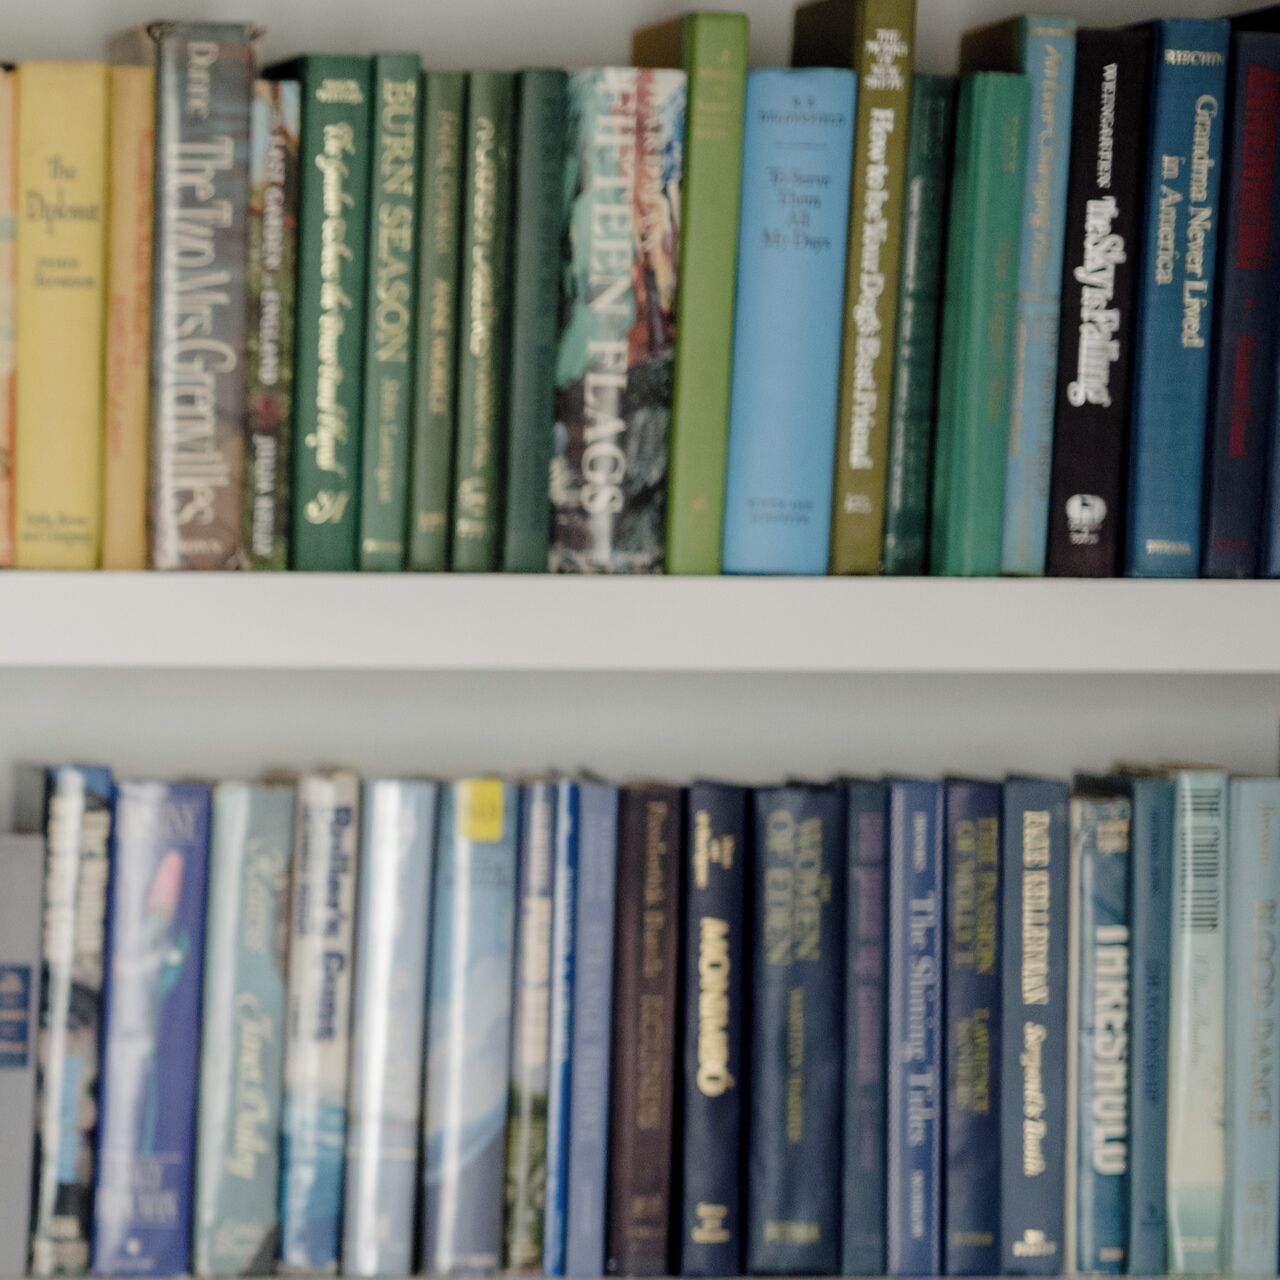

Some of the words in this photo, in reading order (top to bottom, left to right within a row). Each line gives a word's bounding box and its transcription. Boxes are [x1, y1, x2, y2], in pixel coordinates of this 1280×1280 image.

[166, 136, 234, 201] The
[381, 78, 416, 197] BURN
[869, 108, 895, 163] How
[1161, 155, 1185, 180] in
[1187, 94, 1219, 201] Grandma
[164, 202, 234, 269] Two
[589, 80, 634, 316] FIFTEEN
[1154, 184, 1183, 286] America
[1184, 205, 1212, 278] Never
[376, 203, 413, 363] SEASON
[1074, 232, 1127, 287] Sky
[1067, 308, 1121, 408] Falling
[1180, 279, 1207, 348] Lived
[163, 342, 237, 526] Grenvilles
[580, 332, 631, 515] FLAGS
[766, 809, 795, 861] OF
[764, 866, 794, 966] EDEN
[793, 817, 823, 962] WOMEN
[907, 893, 934, 951] The
[1022, 869, 1051, 1005] KELLERMAN
[1249, 896, 1278, 1008] BLOOD
[899, 954, 934, 1062] Shining
[905, 1069, 933, 1148] Tides
[1246, 1014, 1278, 1130] DANCE
